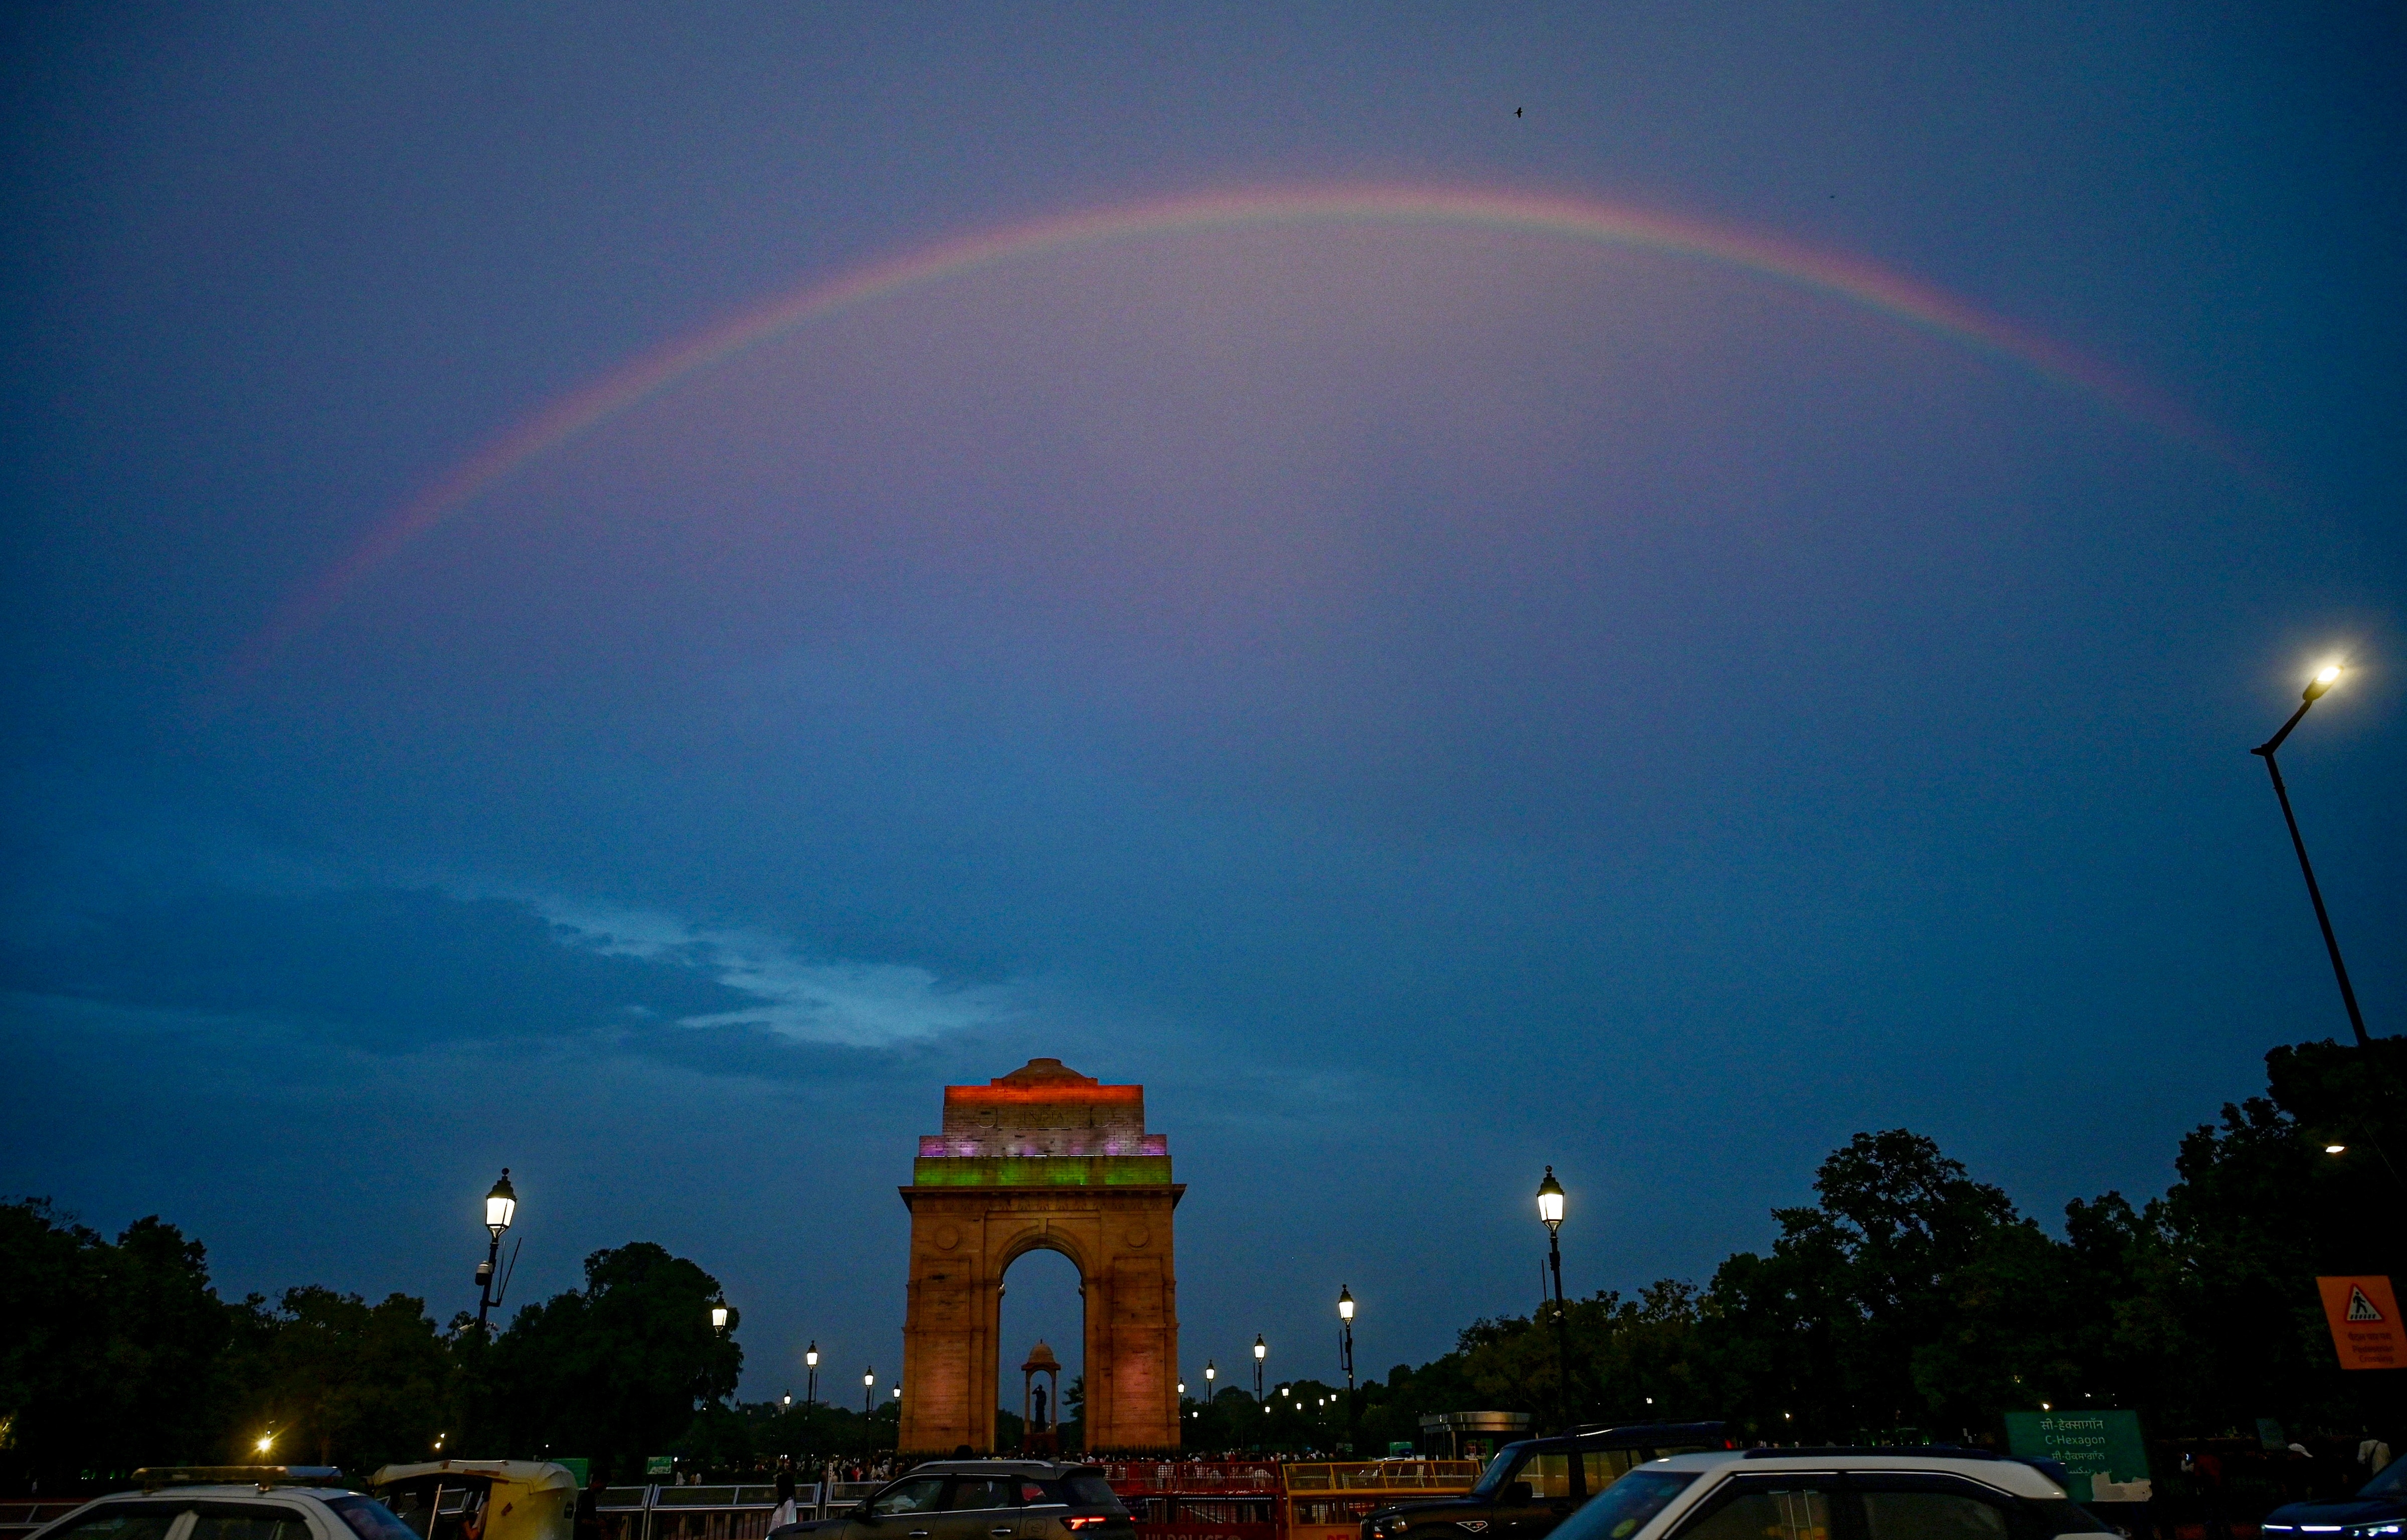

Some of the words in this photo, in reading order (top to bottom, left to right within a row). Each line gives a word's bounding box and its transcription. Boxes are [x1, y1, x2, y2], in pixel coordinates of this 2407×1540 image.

[1023, 1111, 1064, 1121] INDIA
[2352, 1345, 2394, 1353] Pedestrian
[2359, 1355, 2393, 1364] Crossing
[2040, 1418, 2104, 1430] सी-हेक्सागॉन
[2045, 1435, 2106, 1446] C-Hexagon
